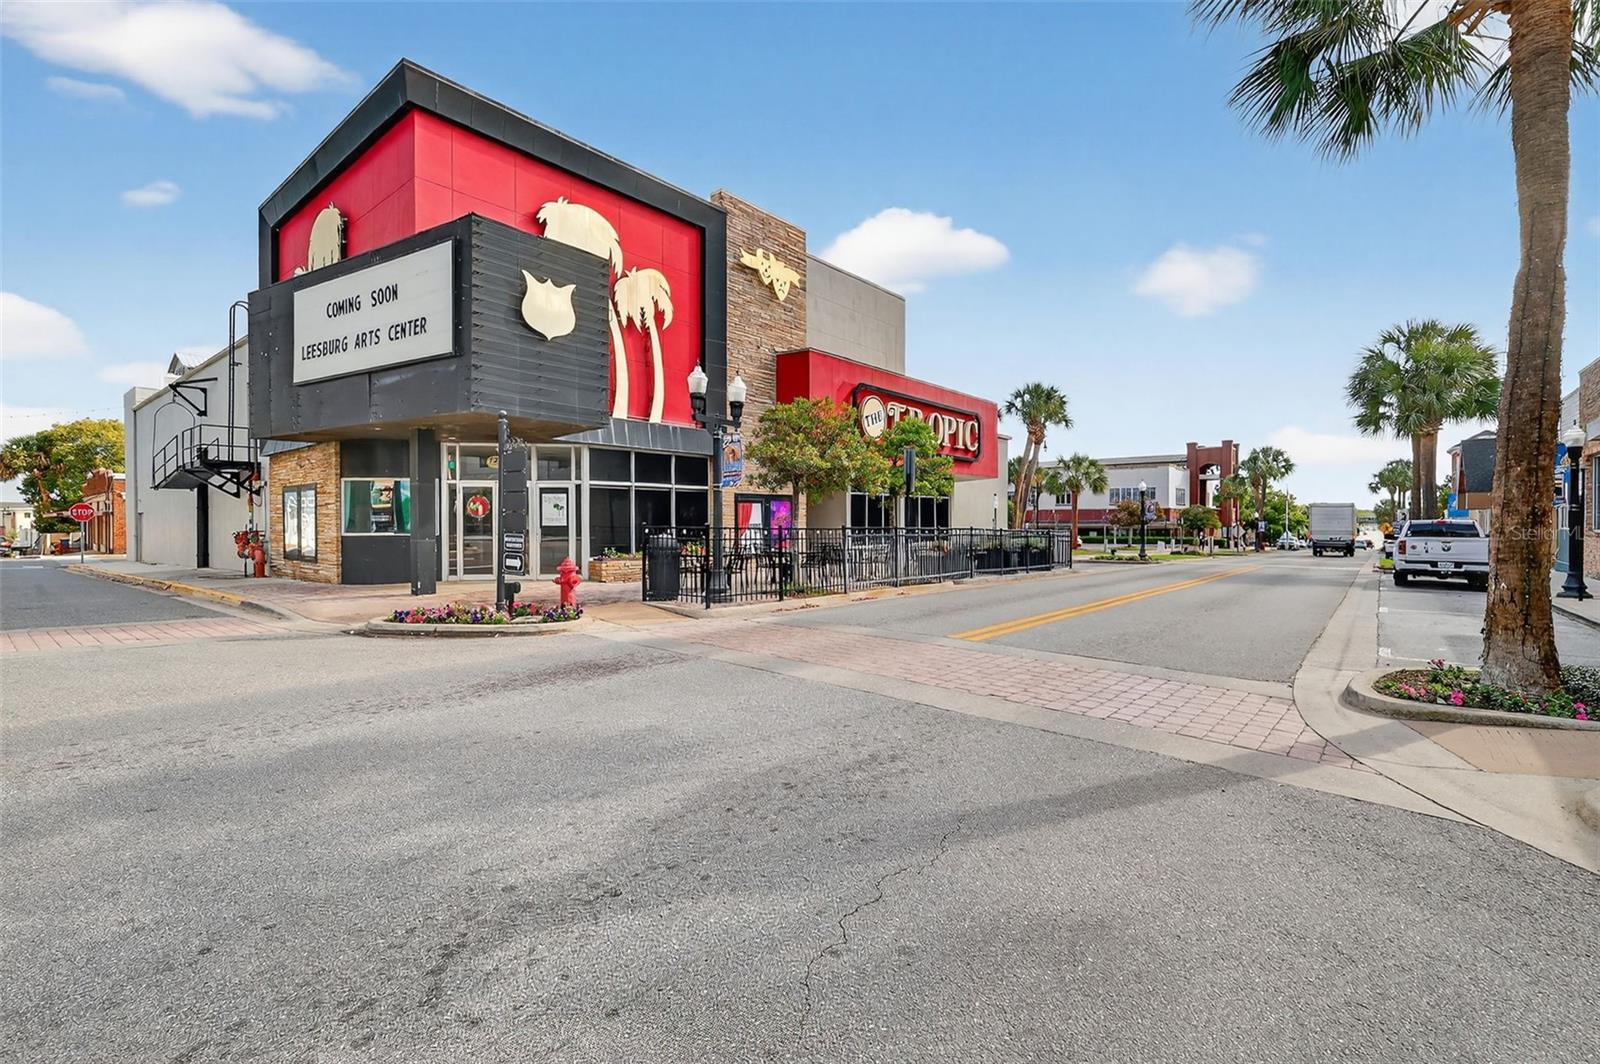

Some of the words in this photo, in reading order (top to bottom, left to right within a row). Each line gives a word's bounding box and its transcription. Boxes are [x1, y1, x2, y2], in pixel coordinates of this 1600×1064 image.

[326, 295, 361, 318] COMING
[371, 283, 398, 307] SOON
[301, 336, 348, 361] LEESBURG
[354, 328, 381, 350] ARTS
[388, 316, 427, 341] CENTER
[865, 409, 882, 427] THE
